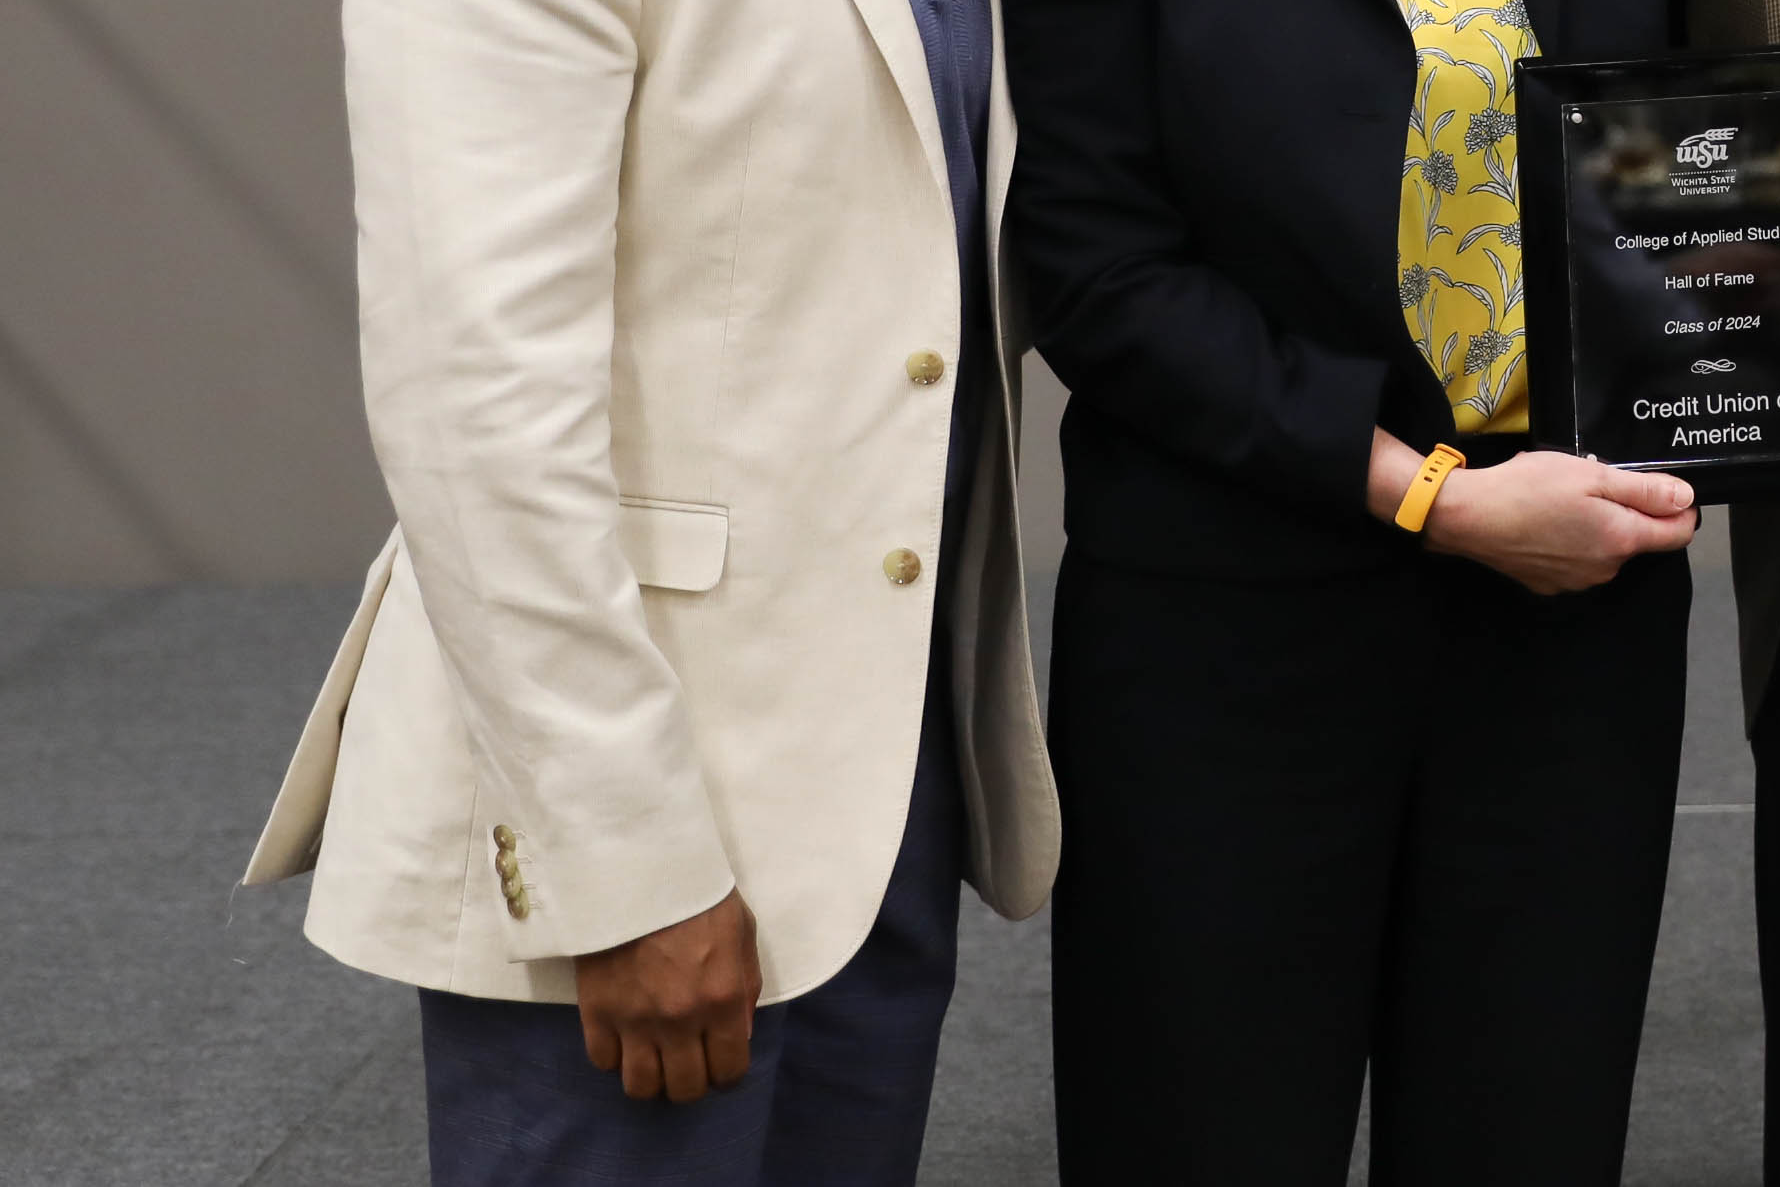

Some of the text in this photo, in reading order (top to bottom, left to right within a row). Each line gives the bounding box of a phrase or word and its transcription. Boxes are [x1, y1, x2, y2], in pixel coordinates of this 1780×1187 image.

[1615, 235, 1669, 251] College
[1673, 231, 1687, 246] of
[1690, 228, 1743, 247] Applied
[1665, 273, 1754, 290] Hall of Fame
[1664, 315, 1761, 335] Class of 2024
[1633, 396, 1699, 420] Credit
[1706, 393, 1769, 414] Union
[1671, 423, 1762, 447] America
